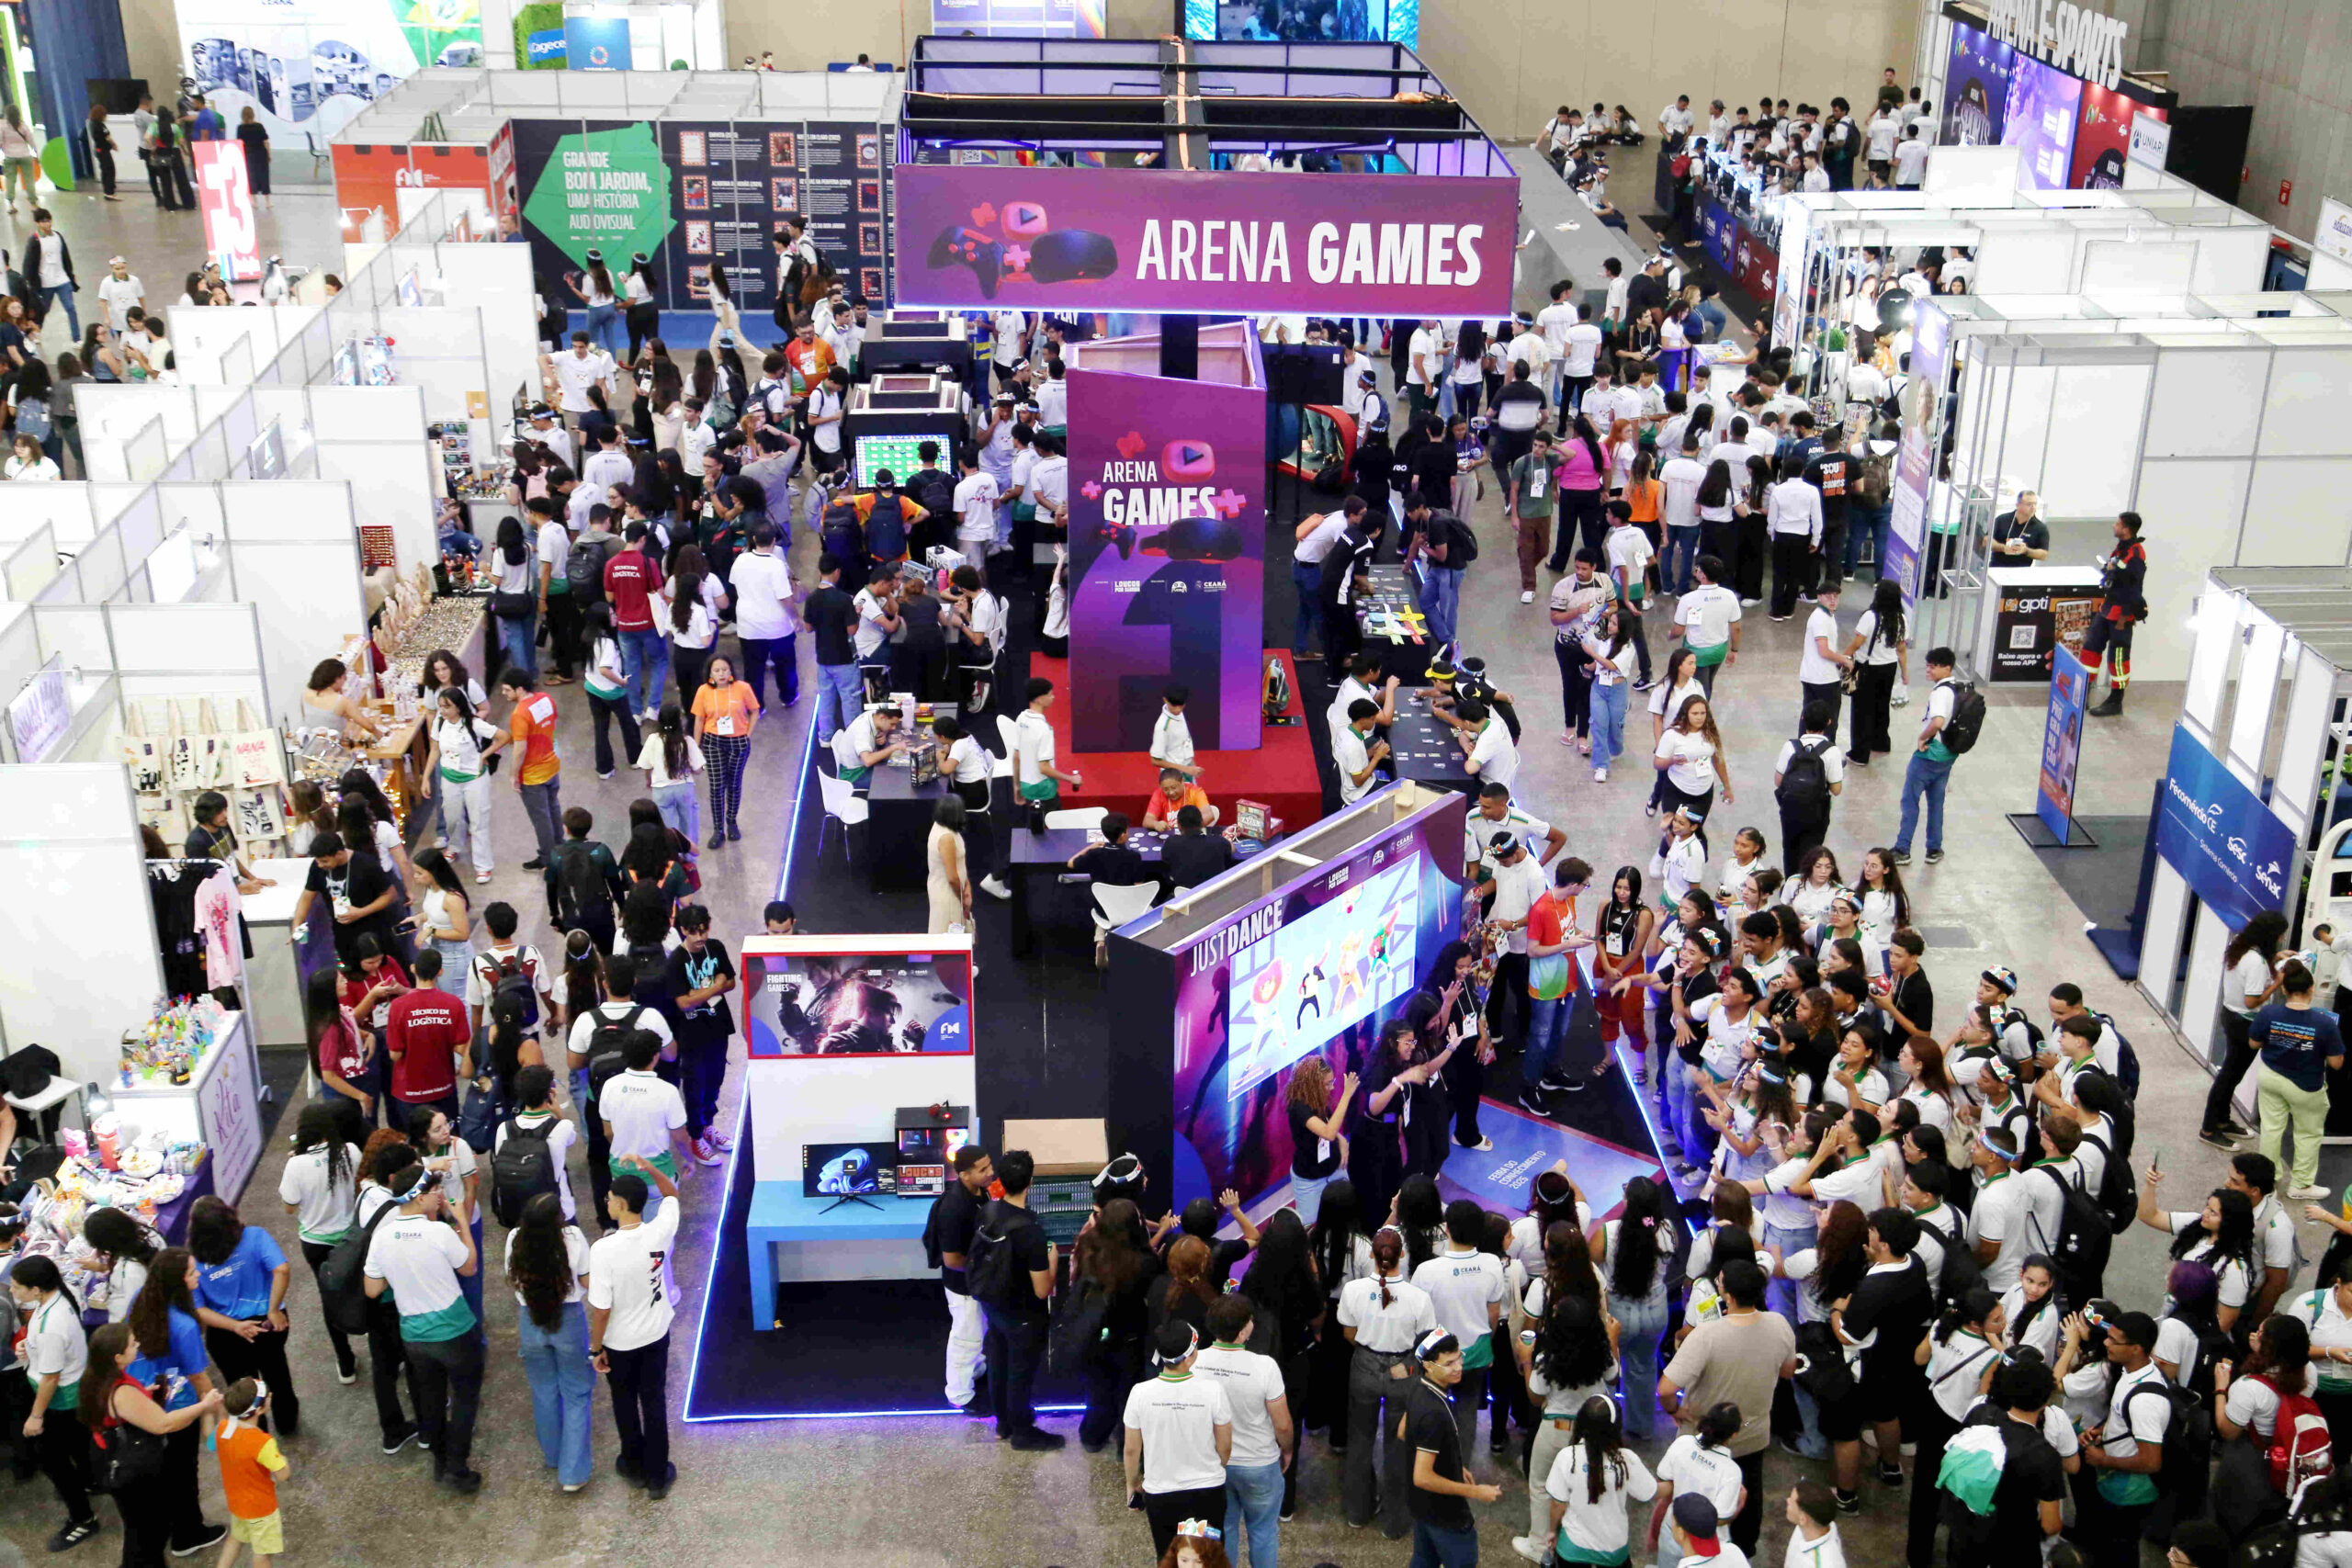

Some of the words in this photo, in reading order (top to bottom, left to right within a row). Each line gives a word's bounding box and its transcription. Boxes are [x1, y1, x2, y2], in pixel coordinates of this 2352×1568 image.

[1985, 0, 2035, 56] ARENA
[2037, 0, 2128, 91] E-SPORTS
[563, 152, 610, 167] GRANDE
[565, 172, 596, 190] BOM
[599, 172, 652, 194] JARDIM,
[567, 193, 590, 208] UMA
[594, 189, 639, 209] HISTÓRIA
[570, 214, 637, 230] AUDOVISUAL
[1136, 219, 1292, 283] ARENA
[1306, 221, 1483, 287] GAMES
[1102, 461, 1158, 483] ARENA
[1103, 487, 1216, 525] GAMES
[1204, 580, 1227, 588] CEARÁ
[2018, 595, 2049, 614] gpti
[2169, 777, 2208, 825] Fecomércio
[2207, 817, 2217, 834] CE
[1396, 831, 1414, 848] CEARÁ
[2199, 839, 2217, 863] Sistema
[2217, 858, 2238, 883] Comércio
[1191, 929, 1228, 977] JUST
[1227, 897, 1283, 956] DANCE
[766, 974, 801, 984] FIGHTING
[767, 984, 790, 992] GAMES
[407, 1016, 452, 1027] LOGÍSTICA
[1487, 1168, 1509, 1182] FEIRA
[1504, 1160, 1518, 1169] DO
[1498, 1150, 1546, 1185] CONHECIMENTO
[1509, 1176, 1529, 1190] 2025
